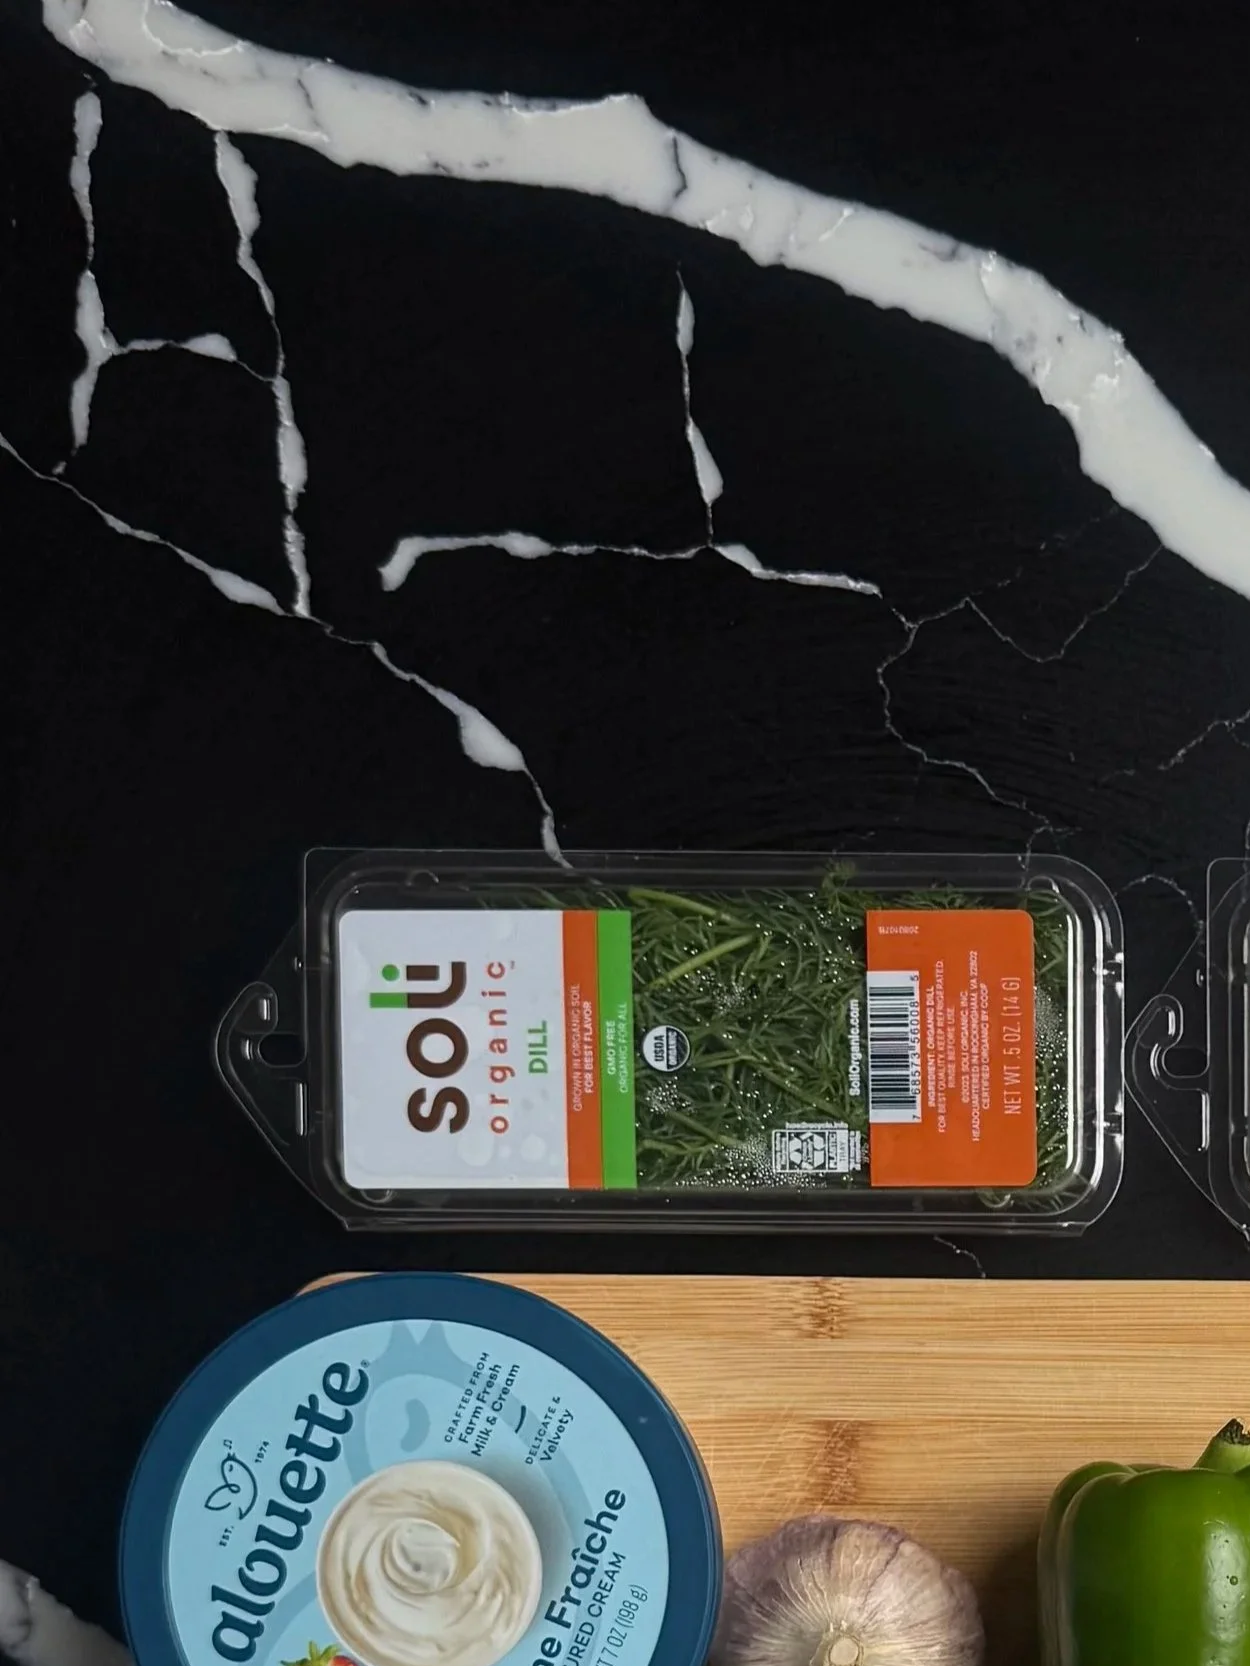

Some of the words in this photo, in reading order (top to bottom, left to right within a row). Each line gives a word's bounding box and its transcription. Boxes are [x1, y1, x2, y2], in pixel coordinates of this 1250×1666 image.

[571, 984, 580, 1007] SOIL
[970, 978, 977, 989] VA
[1001, 977, 1020, 990] G)
[618, 1002, 627, 1020] ALL
[980, 1009, 988, 1021] BY
[1002, 996, 1021, 1016] (14
[572, 1010, 581, 1057] ORGANIC
[583, 1001, 593, 1042] FLAVOR
[606, 1021, 616, 1047] FREE
[619, 1022, 628, 1043] FOR
[909, 1001, 919, 1043] 56008
[1003, 1022, 1021, 1042] OZ.
[369, 961, 470, 1134] soli
[481, 961, 515, 1135] organic
[529, 1021, 547, 1074] DILL
[654, 1035, 665, 1062] USDA
[849, 1000, 861, 1096] SoliOrganic.com
[947, 1027, 955, 1060] BEFORE
[981, 1023, 989, 1062] ORGANIC
[1003, 1048, 1020, 1059] .5
[572, 1059, 581, 1069] IN
[584, 1044, 593, 1070] BEST
[607, 1050, 616, 1075] GMO
[619, 1046, 628, 1093] ORGANIC
[972, 1055, 978, 1064] IN
[585, 1073, 594, 1093] FOR
[910, 1052, 920, 1095] 68573
[981, 1064, 990, 1109] CERTIFIED
[1003, 1064, 1021, 1085] WT
[573, 1072, 582, 1111] GROWN
[972, 1066, 980, 1141] HEADQUARTERED
[1004, 1091, 1022, 1114] NET
[938, 1114, 946, 1132] FOR
[444, 1388, 473, 1443] CRAFTED
[470, 1352, 490, 1386] FROM
[491, 1363, 520, 1413] Cream
[458, 1405, 484, 1444] Farm
[476, 1363, 502, 1404] Fresh
[486, 1416, 498, 1426] &
[525, 1406, 557, 1465] DELICATE
[552, 1396, 561, 1405] &
[540, 1408, 574, 1462] Velvety
[470, 1427, 493, 1457] Milk
[211, 1361, 369, 1662] alouette
[219, 1526, 234, 1547] EST.
[544, 1488, 627, 1630] Fraîche
[587, 1551, 627, 1619] CREAM
[628, 1583, 649, 1602] g)
[614, 1598, 640, 1628] (198
[607, 1626, 628, 1649] OZ
[602, 1646, 618, 1659] 7
